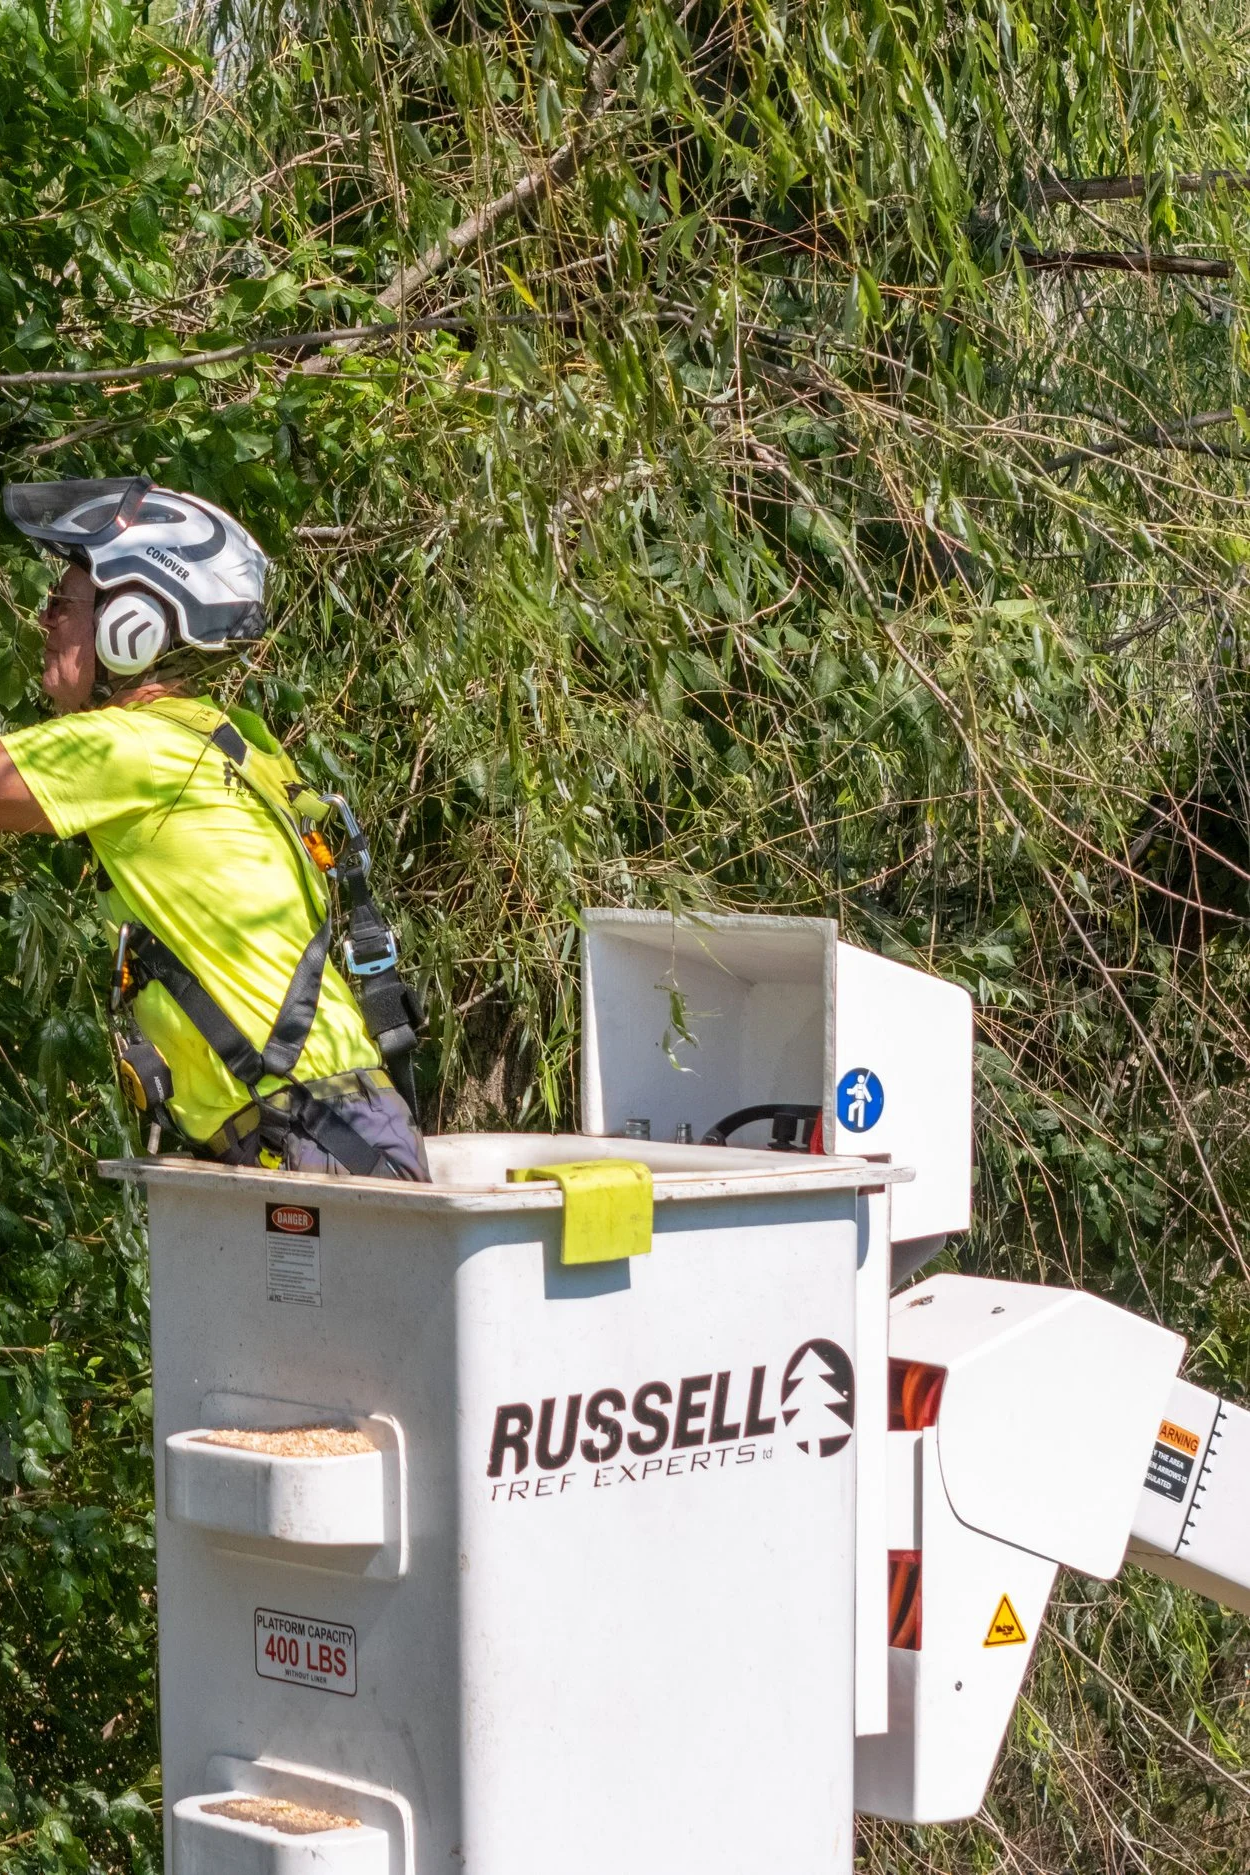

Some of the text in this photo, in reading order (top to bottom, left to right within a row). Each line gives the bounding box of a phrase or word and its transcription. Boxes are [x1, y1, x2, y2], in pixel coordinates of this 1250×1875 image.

[146, 546, 190, 580] CONOVER
[277, 1212, 308, 1226] DANGER
[486, 1365, 776, 1478] RUSSELL
[1159, 1425, 1198, 1452] ARNING
[594, 1443, 756, 1488] EXPERTS
[1157, 1452, 1170, 1463] THE
[1168, 1457, 1184, 1469] AREA
[1146, 1473, 1172, 1489] SULATED
[1157, 1464, 1182, 1481] ARROWS
[1180, 1475, 1188, 1485] IS
[256, 1614, 353, 1646] PLATFORM CAPACITY
[265, 1633, 347, 1677] 400 LBS
[285, 1668, 327, 1684] WITHOUT LINER
